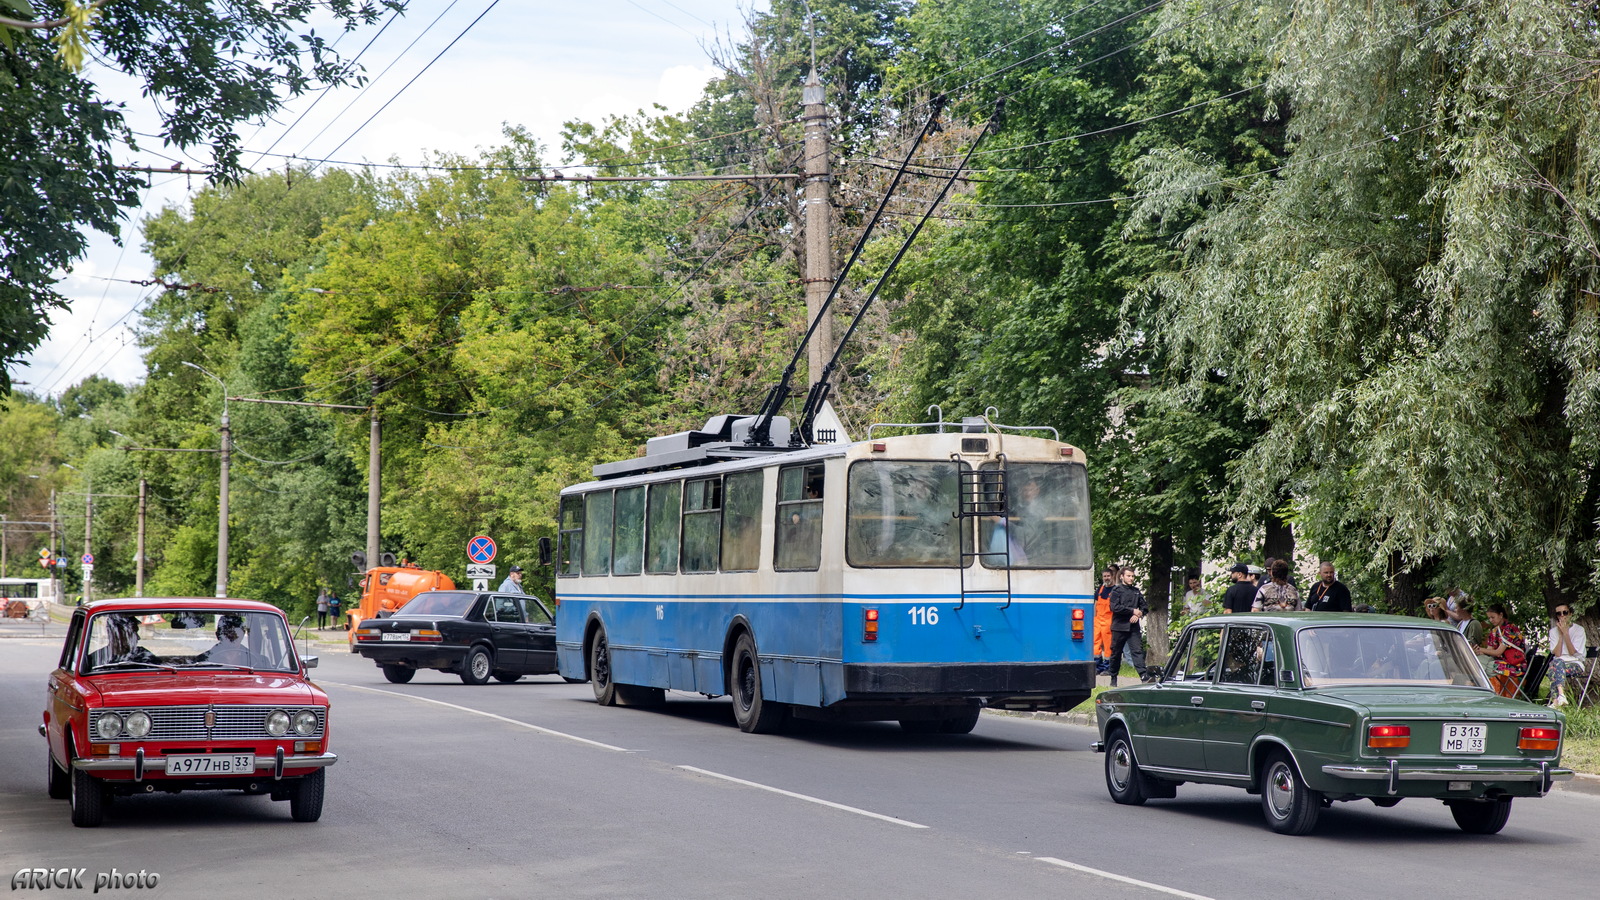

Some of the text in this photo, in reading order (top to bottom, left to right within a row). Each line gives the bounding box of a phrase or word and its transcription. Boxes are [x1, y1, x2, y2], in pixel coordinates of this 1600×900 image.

[656, 605, 664, 620] 116
[908, 606, 939, 625] 116
[1450, 727, 1480, 737] В 313
[1447, 739, 1483, 750] МВ 33
[173, 757, 249, 772] А977НВ 33
